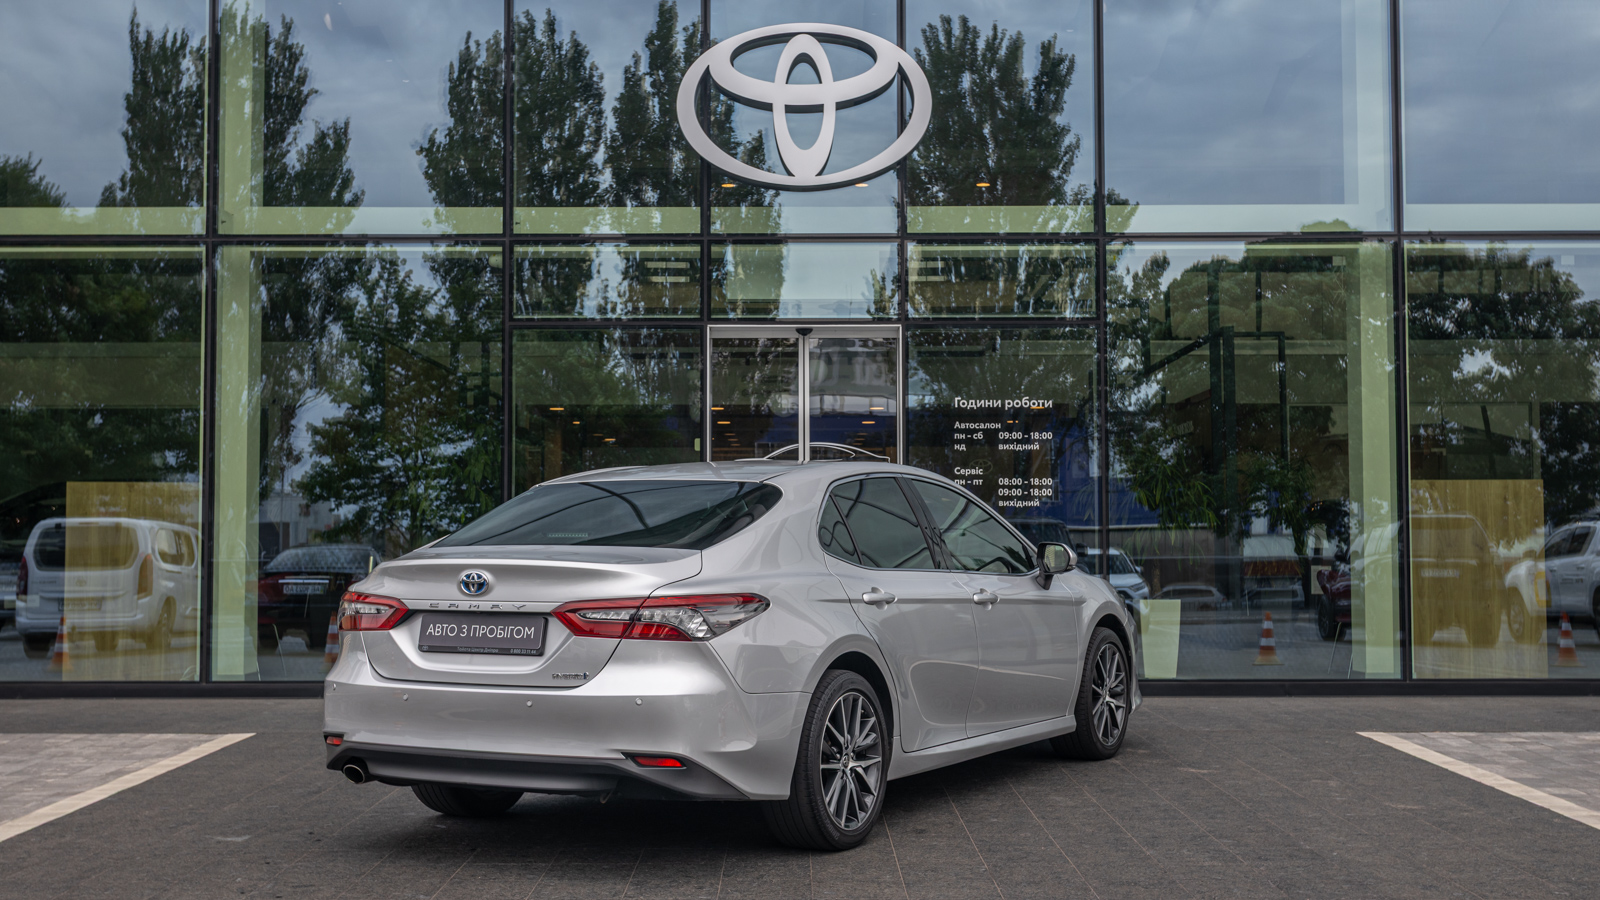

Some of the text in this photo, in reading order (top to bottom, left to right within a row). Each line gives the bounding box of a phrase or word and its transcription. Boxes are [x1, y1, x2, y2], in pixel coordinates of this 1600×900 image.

[954, 396, 1053, 410] Години роботи
[954, 421, 1002, 429] Автосалон
[973, 431, 984, 440] сб
[998, 431, 1023, 440] 09:00
[1030, 431, 1053, 440] 18:00
[954, 442, 1040, 451] нд вихідний
[954, 466, 984, 476] Сервіс
[998, 477, 1023, 486] 08:00
[1030, 477, 1053, 486] 18:00
[998, 488, 1023, 497] 09:00
[1030, 488, 1053, 497] 18:00
[998, 498, 1040, 508] вихідний
[428, 602, 527, 611] CAMRY
[426, 623, 458, 637] АВТО
[470, 625, 535, 639] ПРОБІГОМ
